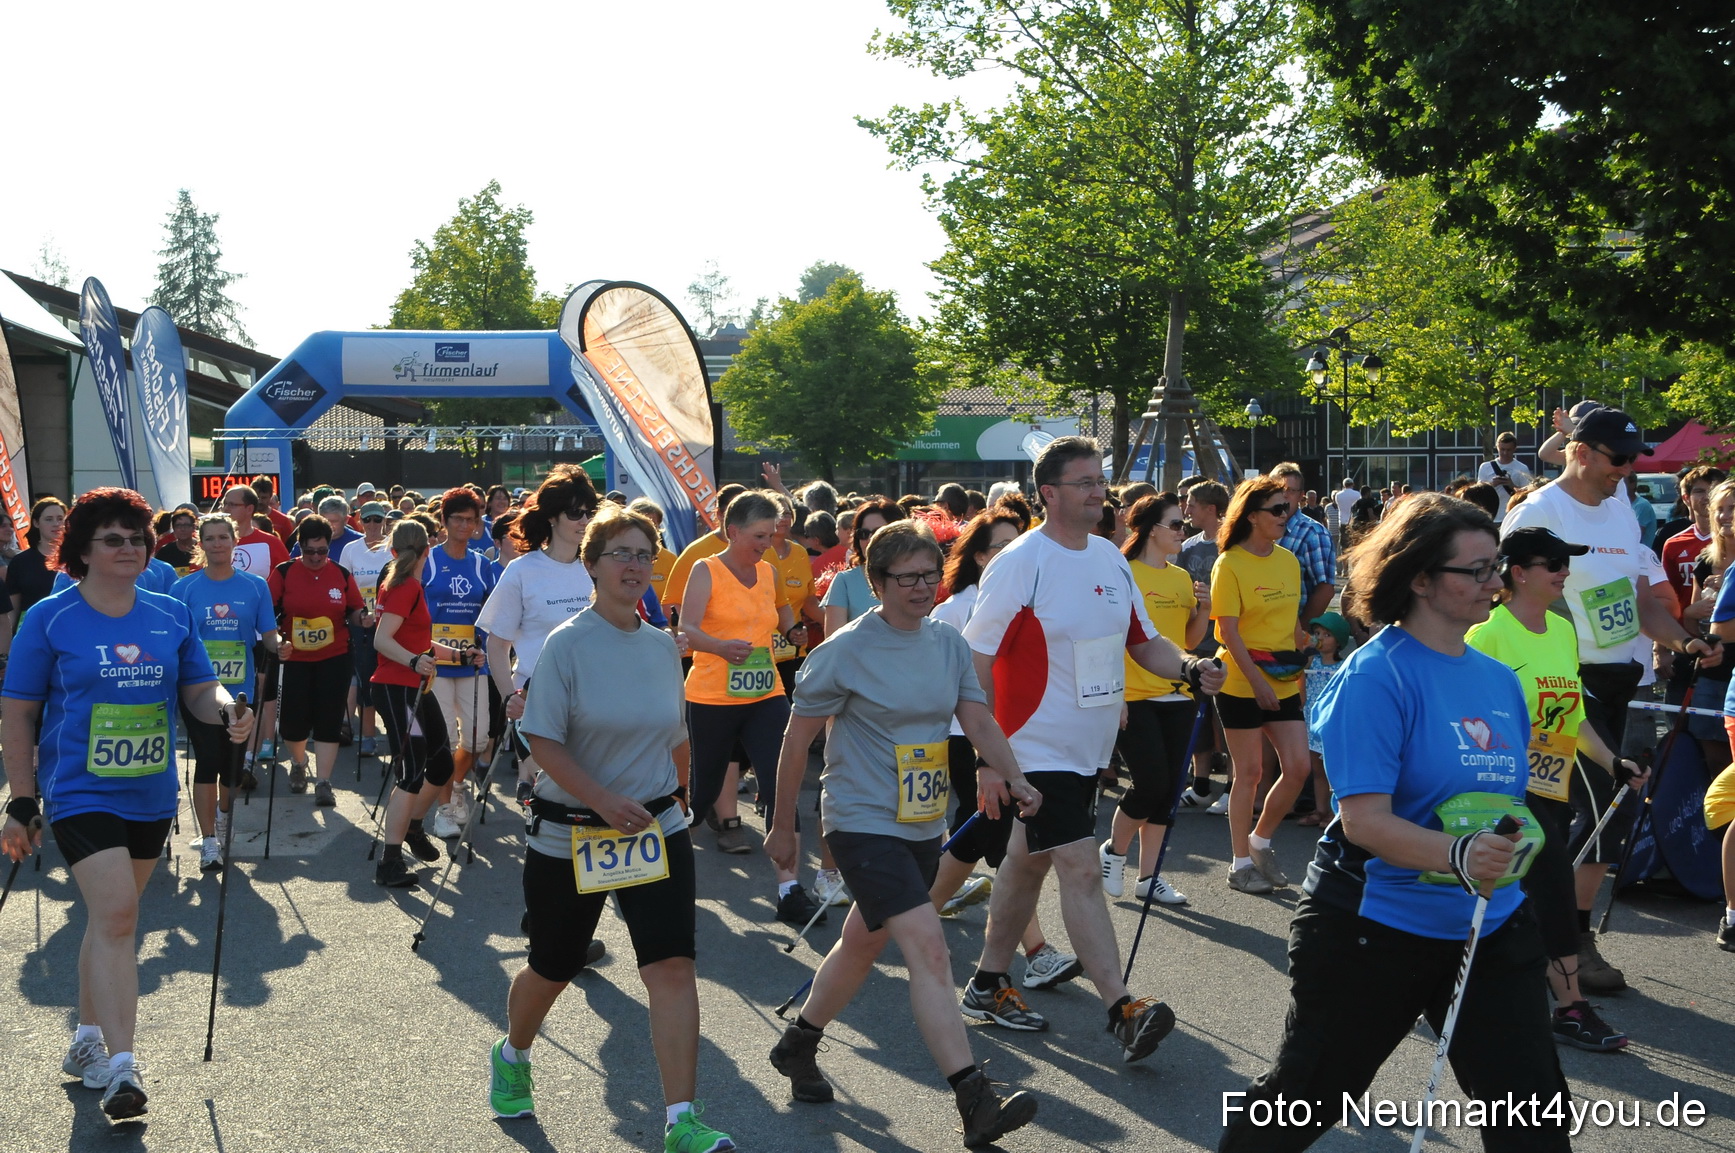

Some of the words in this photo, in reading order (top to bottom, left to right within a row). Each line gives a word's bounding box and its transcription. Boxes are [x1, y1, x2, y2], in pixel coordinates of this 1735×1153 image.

[442, 347, 468, 356] Fischer
[423, 363, 499, 377] firmenlauf
[274, 387, 317, 397] Fischer
[1597, 547, 1629, 555] KLEBL
[205, 606, 213, 620] I
[206, 617, 239, 627] camping
[1598, 599, 1634, 631] 556
[298, 629, 327, 643] 150
[95, 645, 112, 666] I
[100, 662, 164, 679] camping
[730, 670, 774, 691] 5090
[1535, 676, 1579, 689] Müller
[1449, 721, 1470, 750] I
[94, 736, 166, 767] 5048
[1460, 751, 1516, 773] camping
[1528, 751, 1566, 784] 282
[902, 768, 949, 803] 1364
[576, 832, 661, 873] 1370
